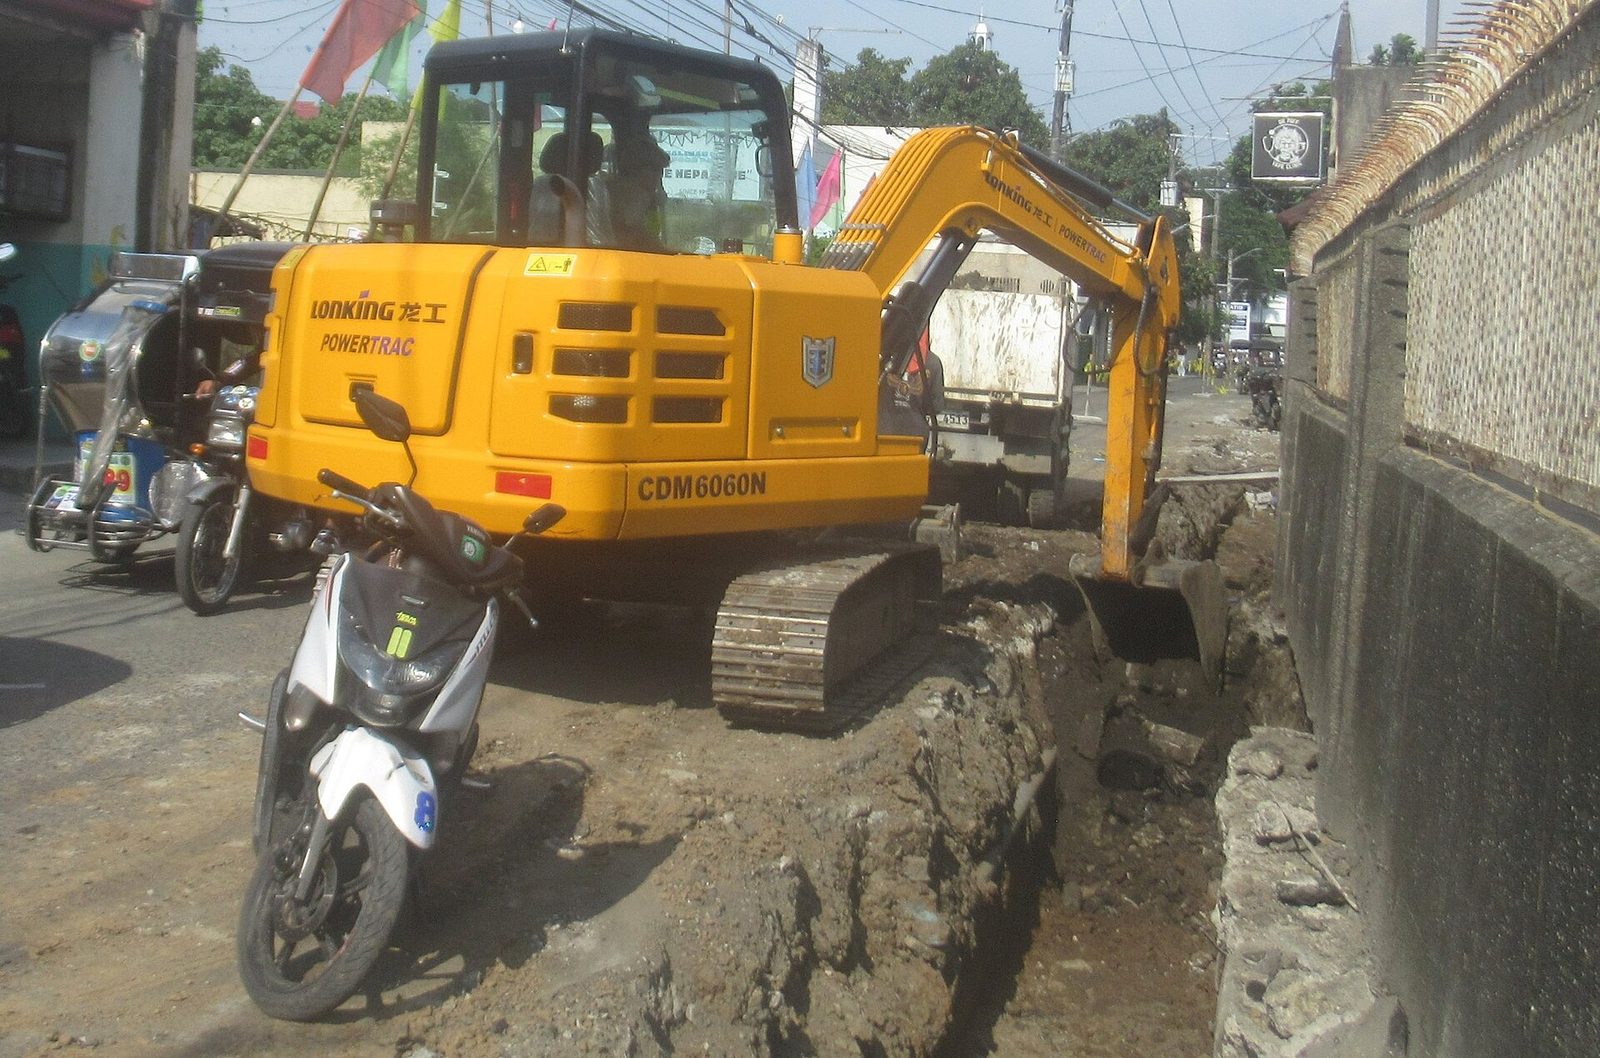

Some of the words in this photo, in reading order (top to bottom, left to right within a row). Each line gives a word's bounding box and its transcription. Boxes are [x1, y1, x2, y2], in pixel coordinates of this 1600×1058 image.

[1059, 224, 1105, 263] POWERTRAC
[399, 302, 447, 323] 龙工
[320, 333, 415, 356] POWERTRAC
[638, 471, 767, 501] CDM6060N
